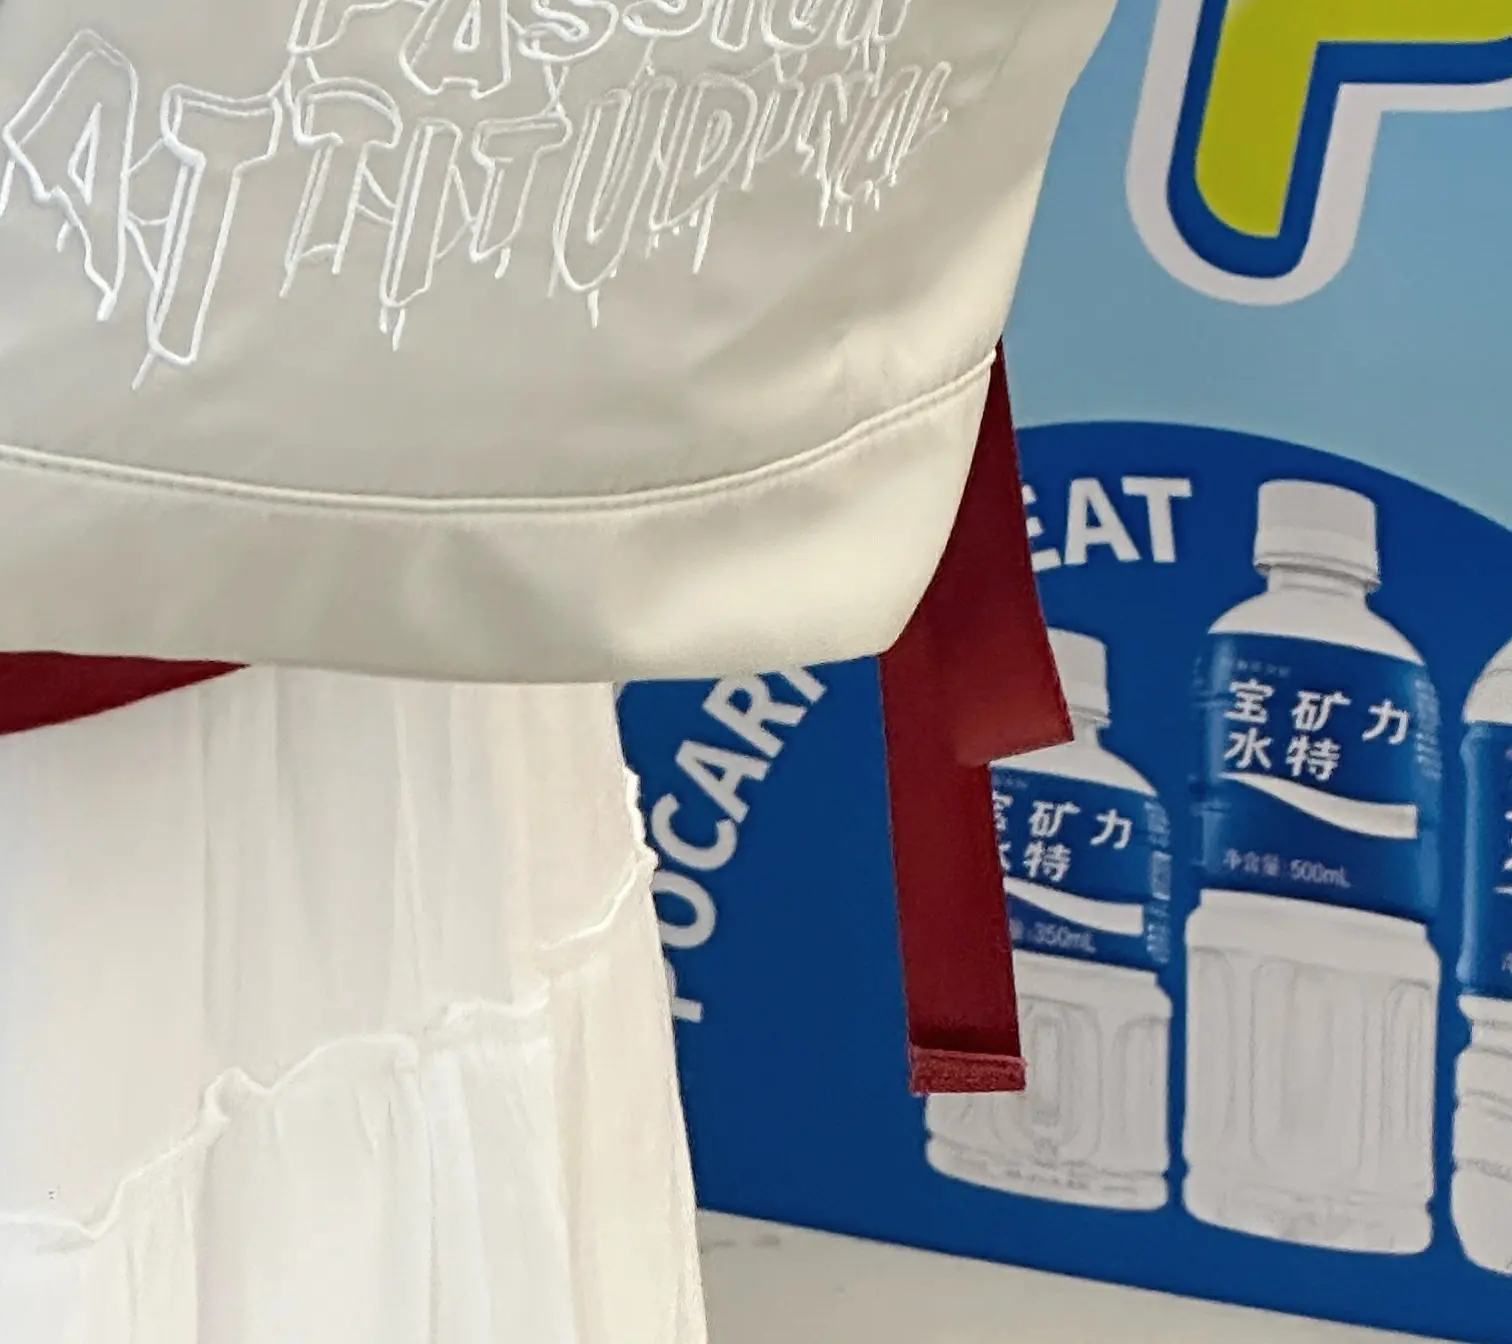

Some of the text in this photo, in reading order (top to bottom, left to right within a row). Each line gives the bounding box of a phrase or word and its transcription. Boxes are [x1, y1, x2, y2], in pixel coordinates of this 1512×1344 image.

[1223, 678, 1410, 745] 宝矿力
[1223, 728, 1342, 782] 水特
